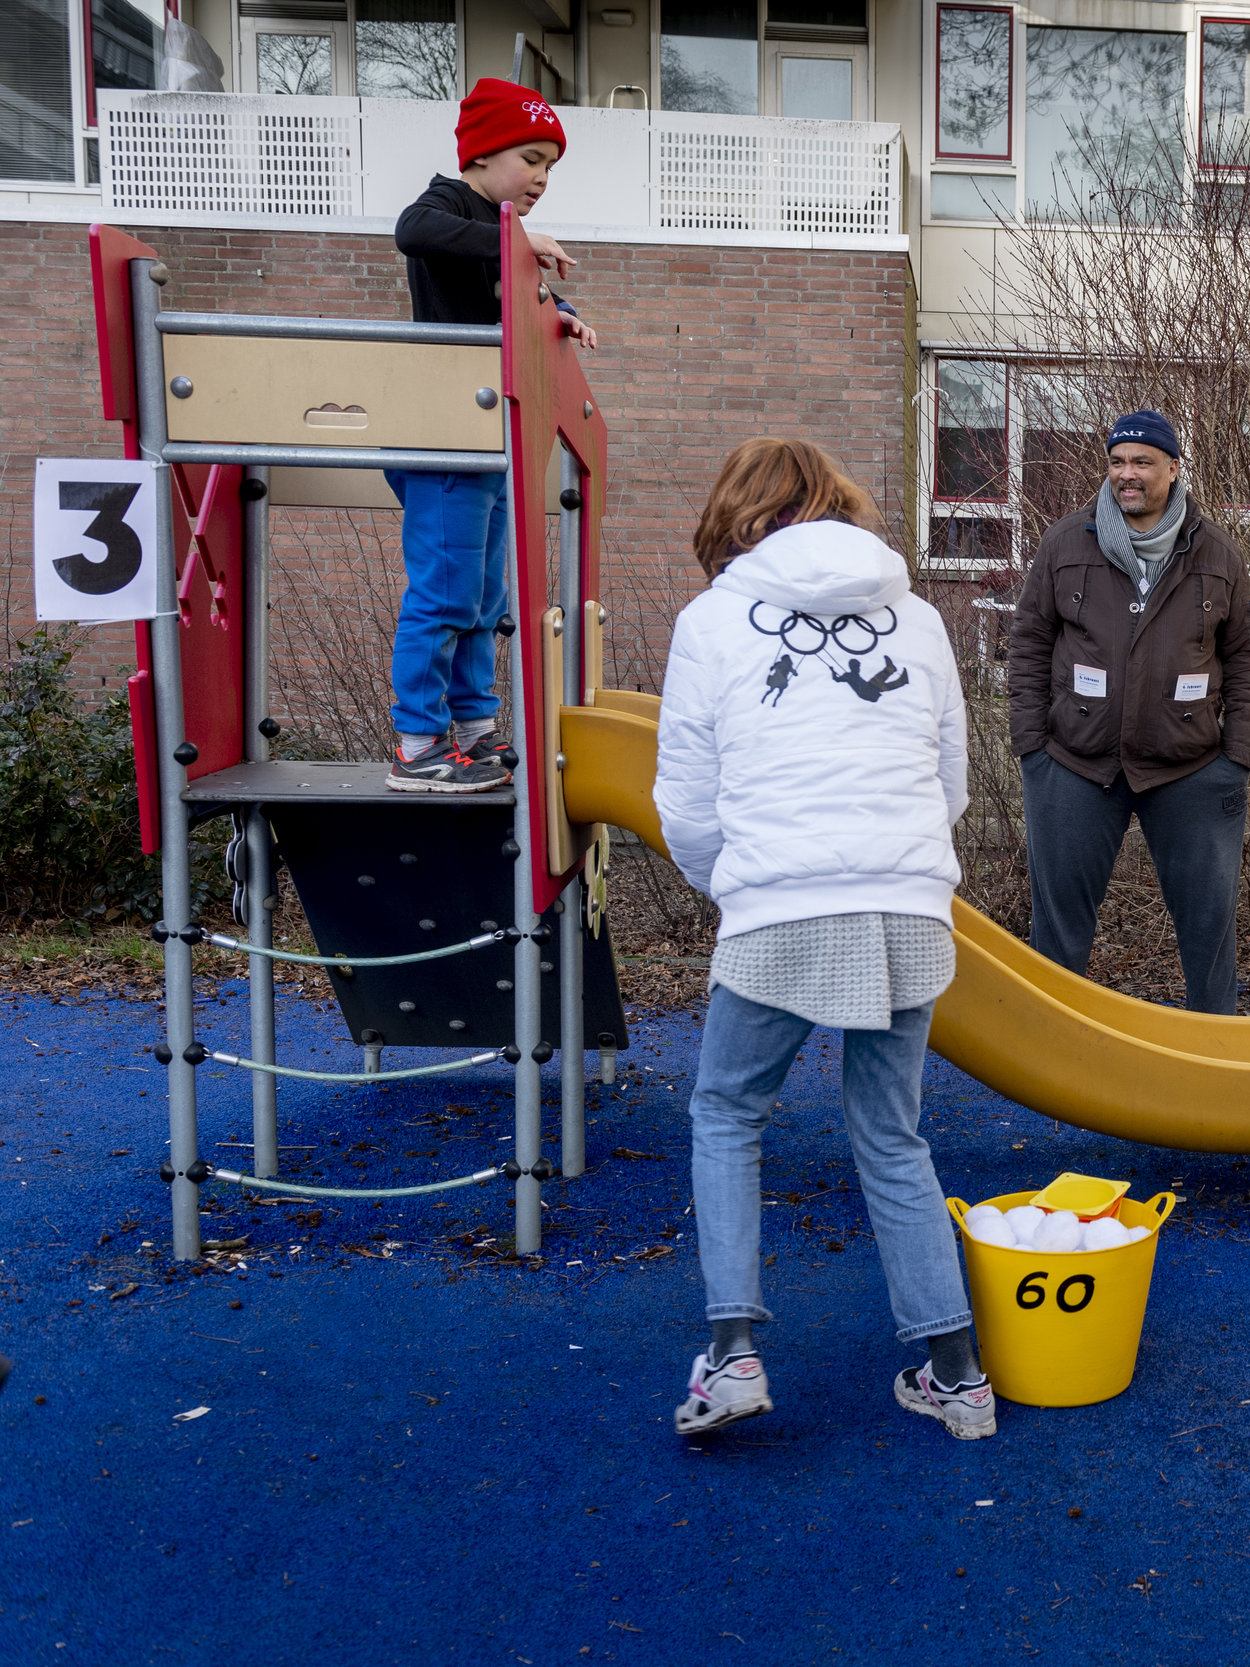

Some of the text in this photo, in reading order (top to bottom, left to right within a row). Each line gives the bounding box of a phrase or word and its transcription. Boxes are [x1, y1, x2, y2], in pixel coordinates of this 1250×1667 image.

[1112, 430, 1145, 439] SALT
[52, 481, 143, 596] 3
[1015, 1271, 1096, 1313] 60
